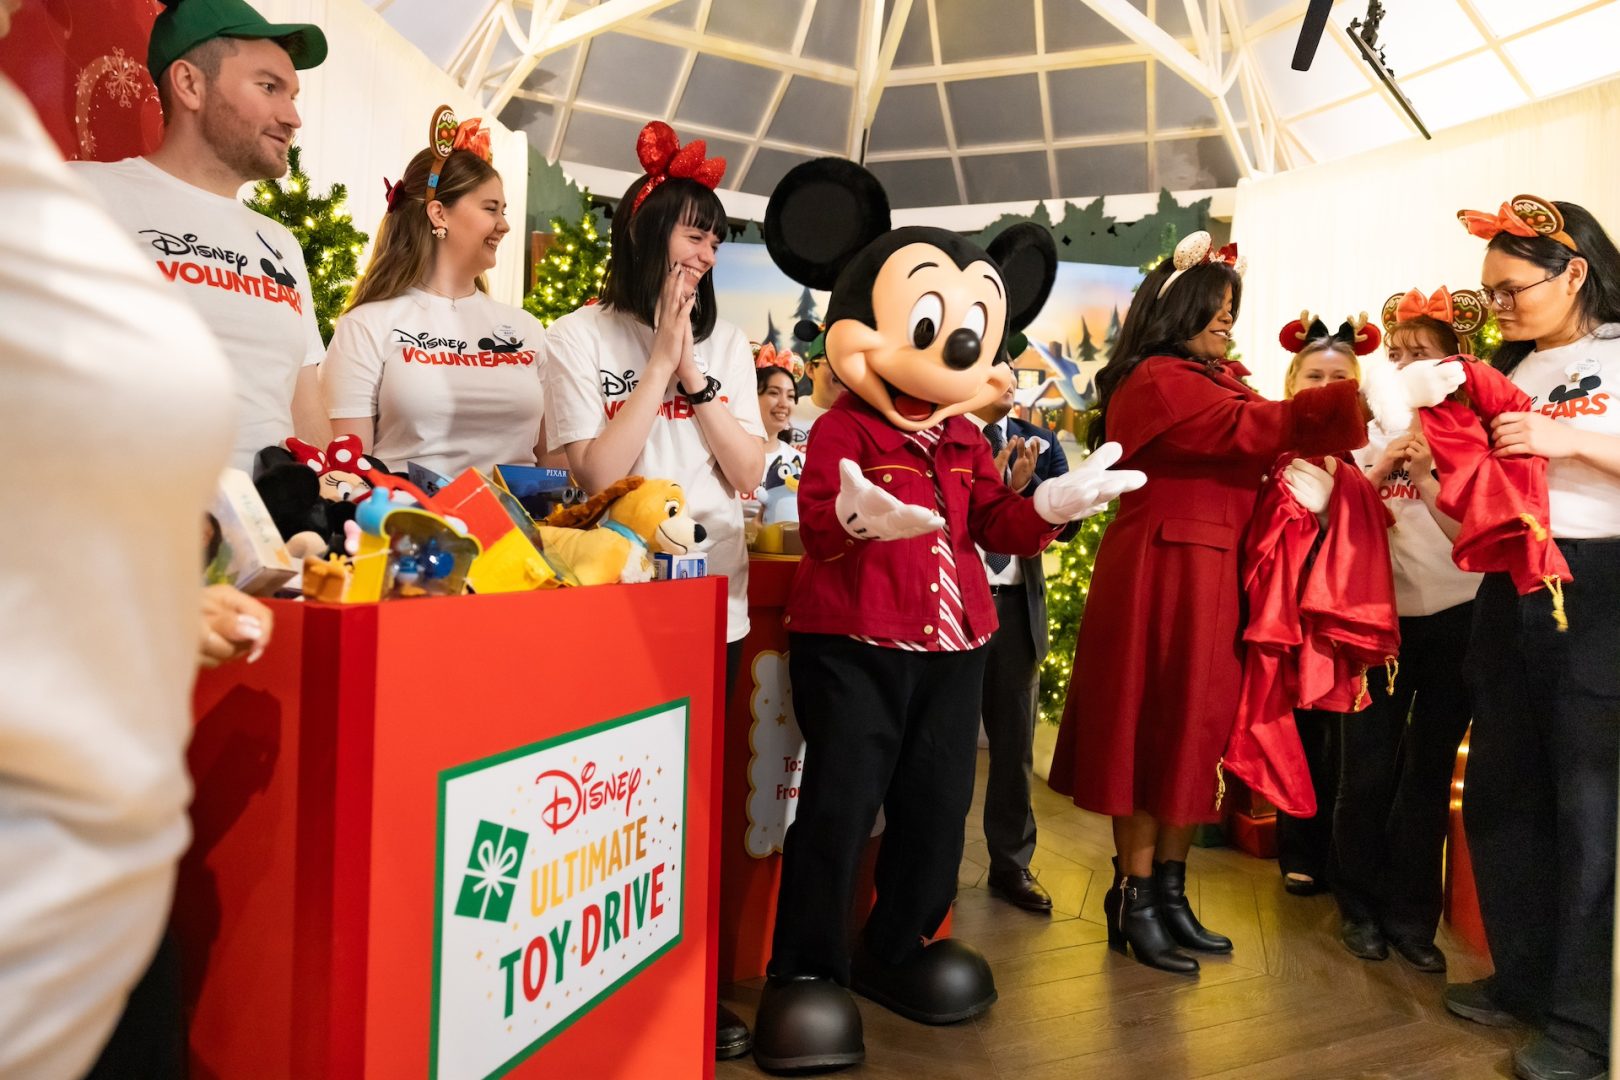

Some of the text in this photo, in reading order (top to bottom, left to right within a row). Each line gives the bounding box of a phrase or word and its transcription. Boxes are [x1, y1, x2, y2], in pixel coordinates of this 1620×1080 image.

[546, 469, 567, 478] PIXAR
[783, 756, 801, 773] To:
[535, 761, 641, 835] Disney
[776, 784, 801, 800] Fro
[530, 815, 648, 918] ULTIMATE
[499, 862, 665, 1020] TOY DRIVE
